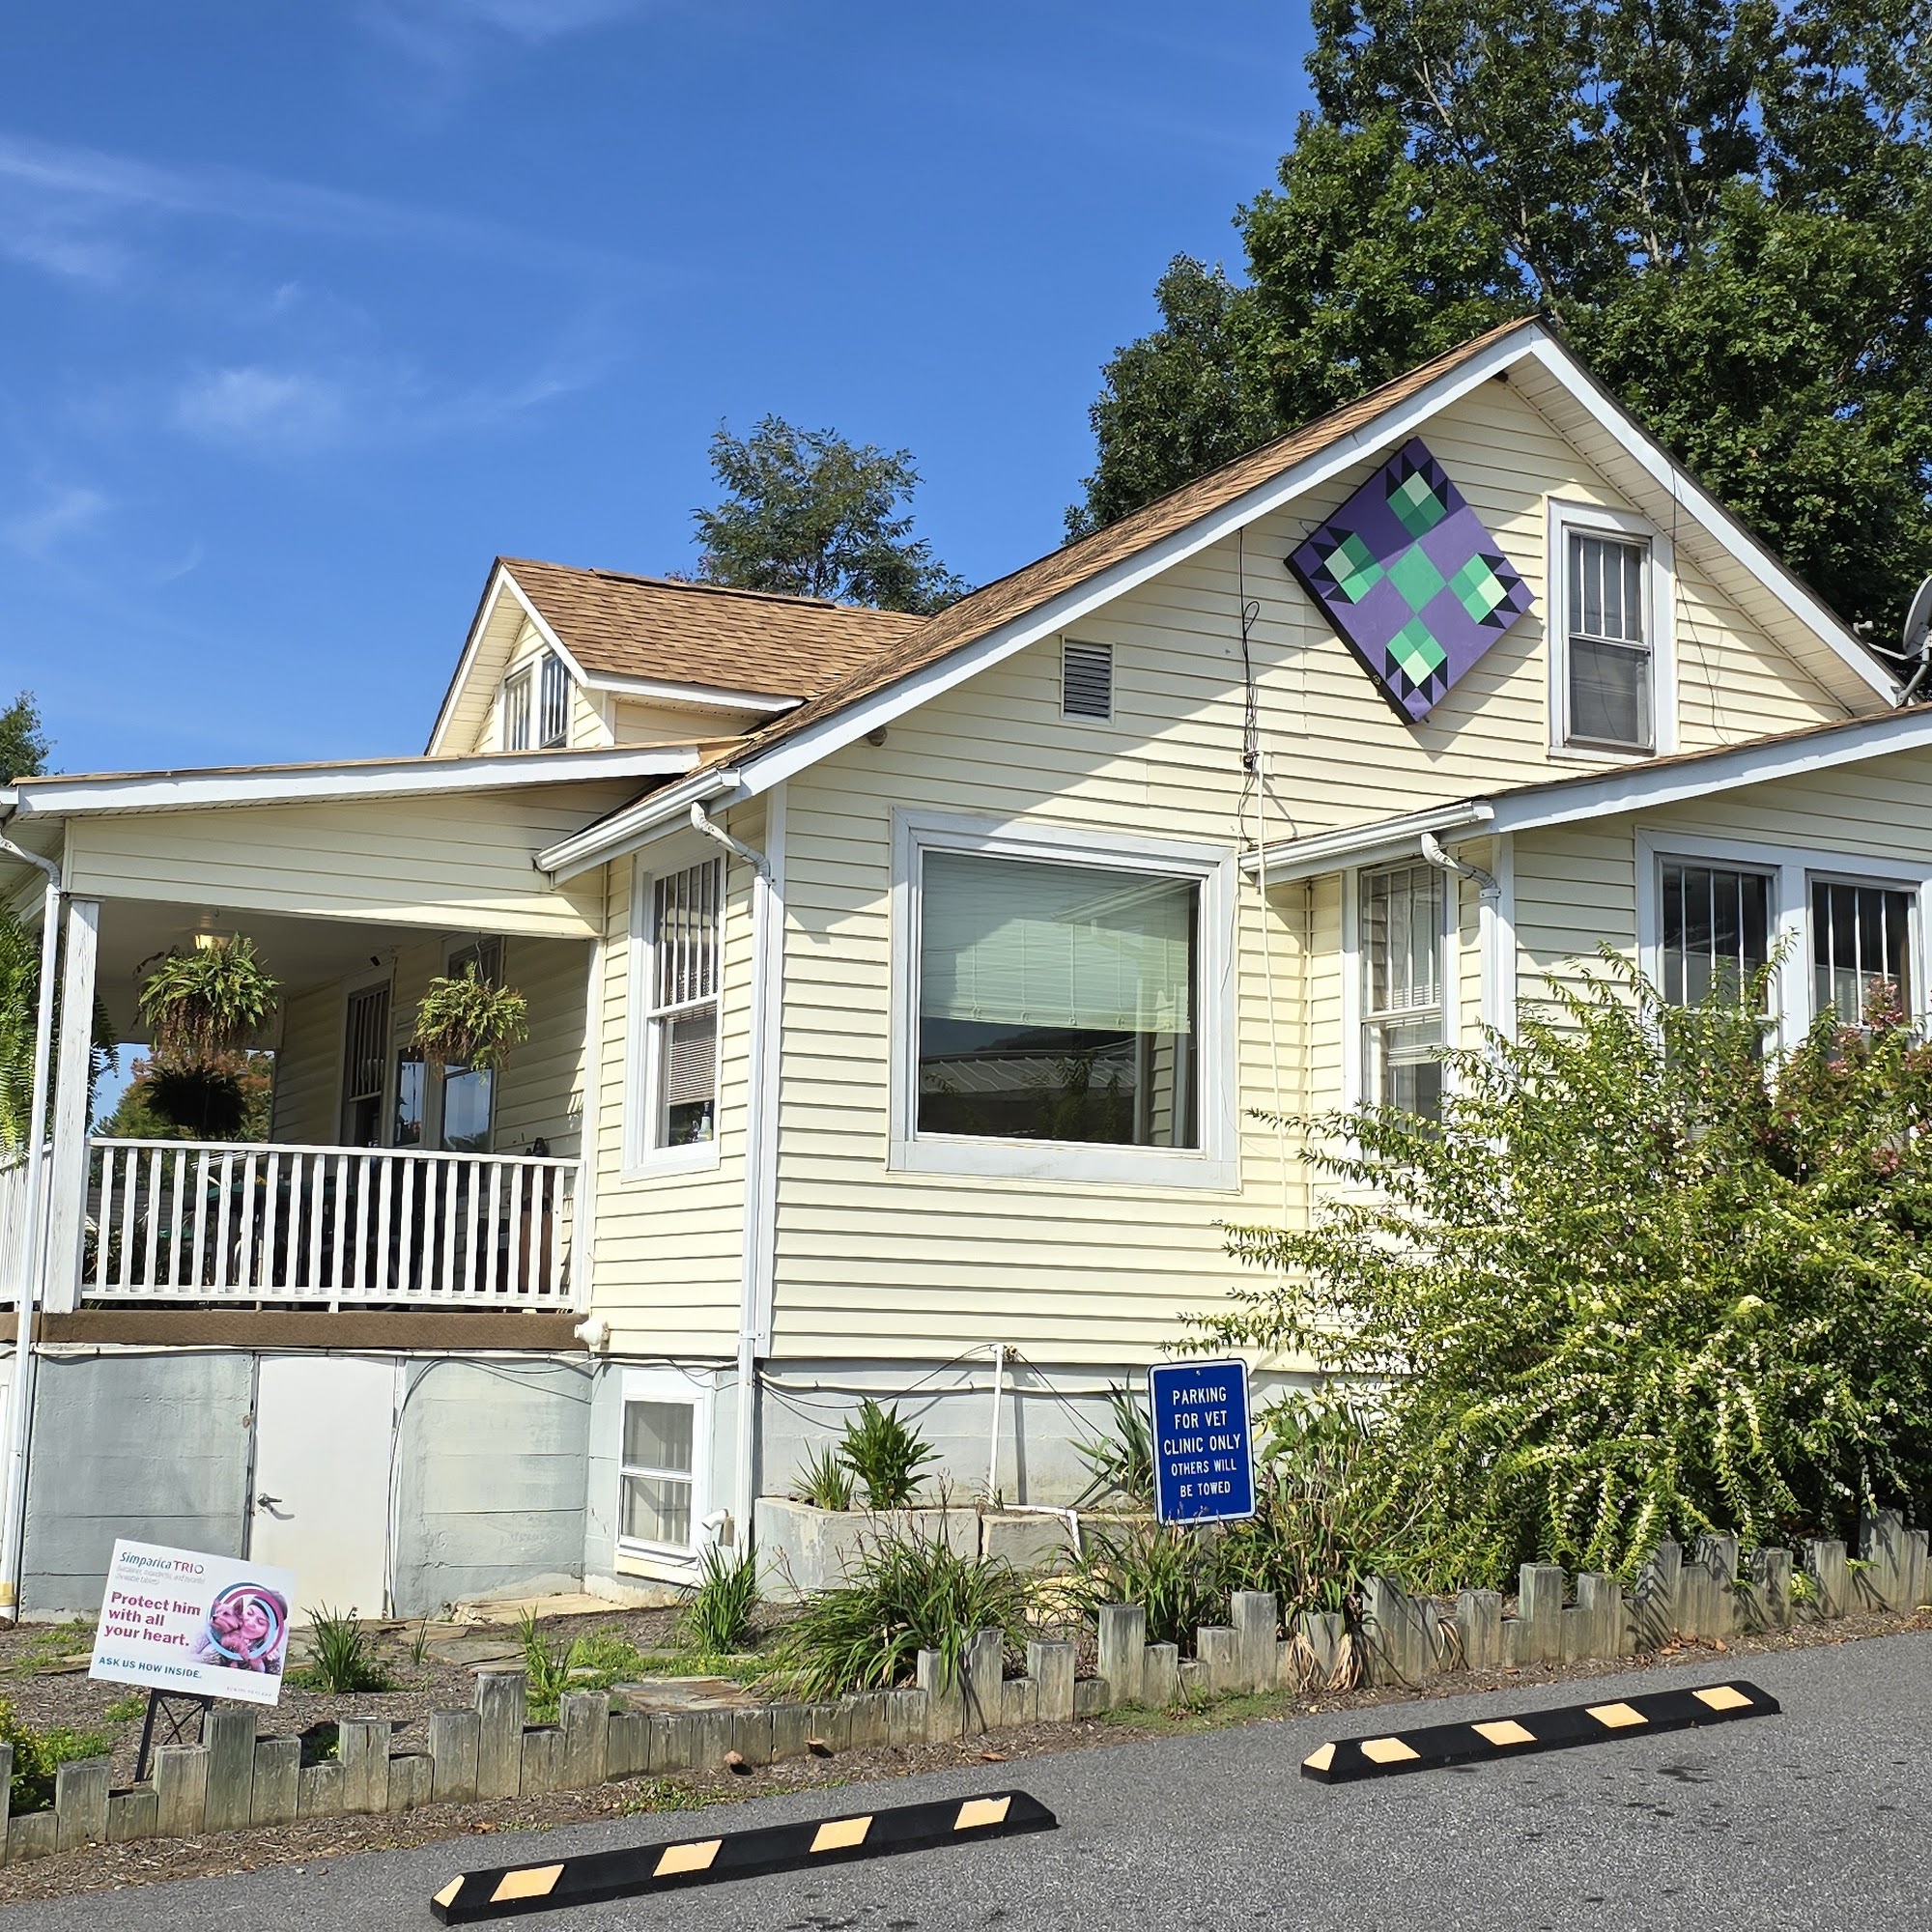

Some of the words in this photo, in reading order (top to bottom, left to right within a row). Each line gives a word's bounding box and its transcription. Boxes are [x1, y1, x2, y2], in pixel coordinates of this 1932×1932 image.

[1173, 1386, 1227, 1406] PARKING
[1175, 1412, 1199, 1430] FOR
[1205, 1410, 1227, 1427] VET
[1163, 1436, 1204, 1456] CLINIC
[1209, 1434, 1240, 1451] ONLY
[1171, 1461, 1209, 1476] OTHERS
[1213, 1458, 1237, 1472] WILL
[1179, 1485, 1193, 1497] BE
[1197, 1481, 1231, 1495] TOWED
[111, 1591, 169, 1611] Protect
[172, 1602, 201, 1616] him
[108, 1608, 142, 1624] with
[145, 1613, 164, 1626] all
[103, 1625, 140, 1639] your
[143, 1629, 189, 1646] heart.
[99, 1656, 120, 1666] ASK
[122, 1660, 135, 1669] US
[138, 1662, 162, 1673] HOW
[164, 1666, 202, 1679] INSIDE.
